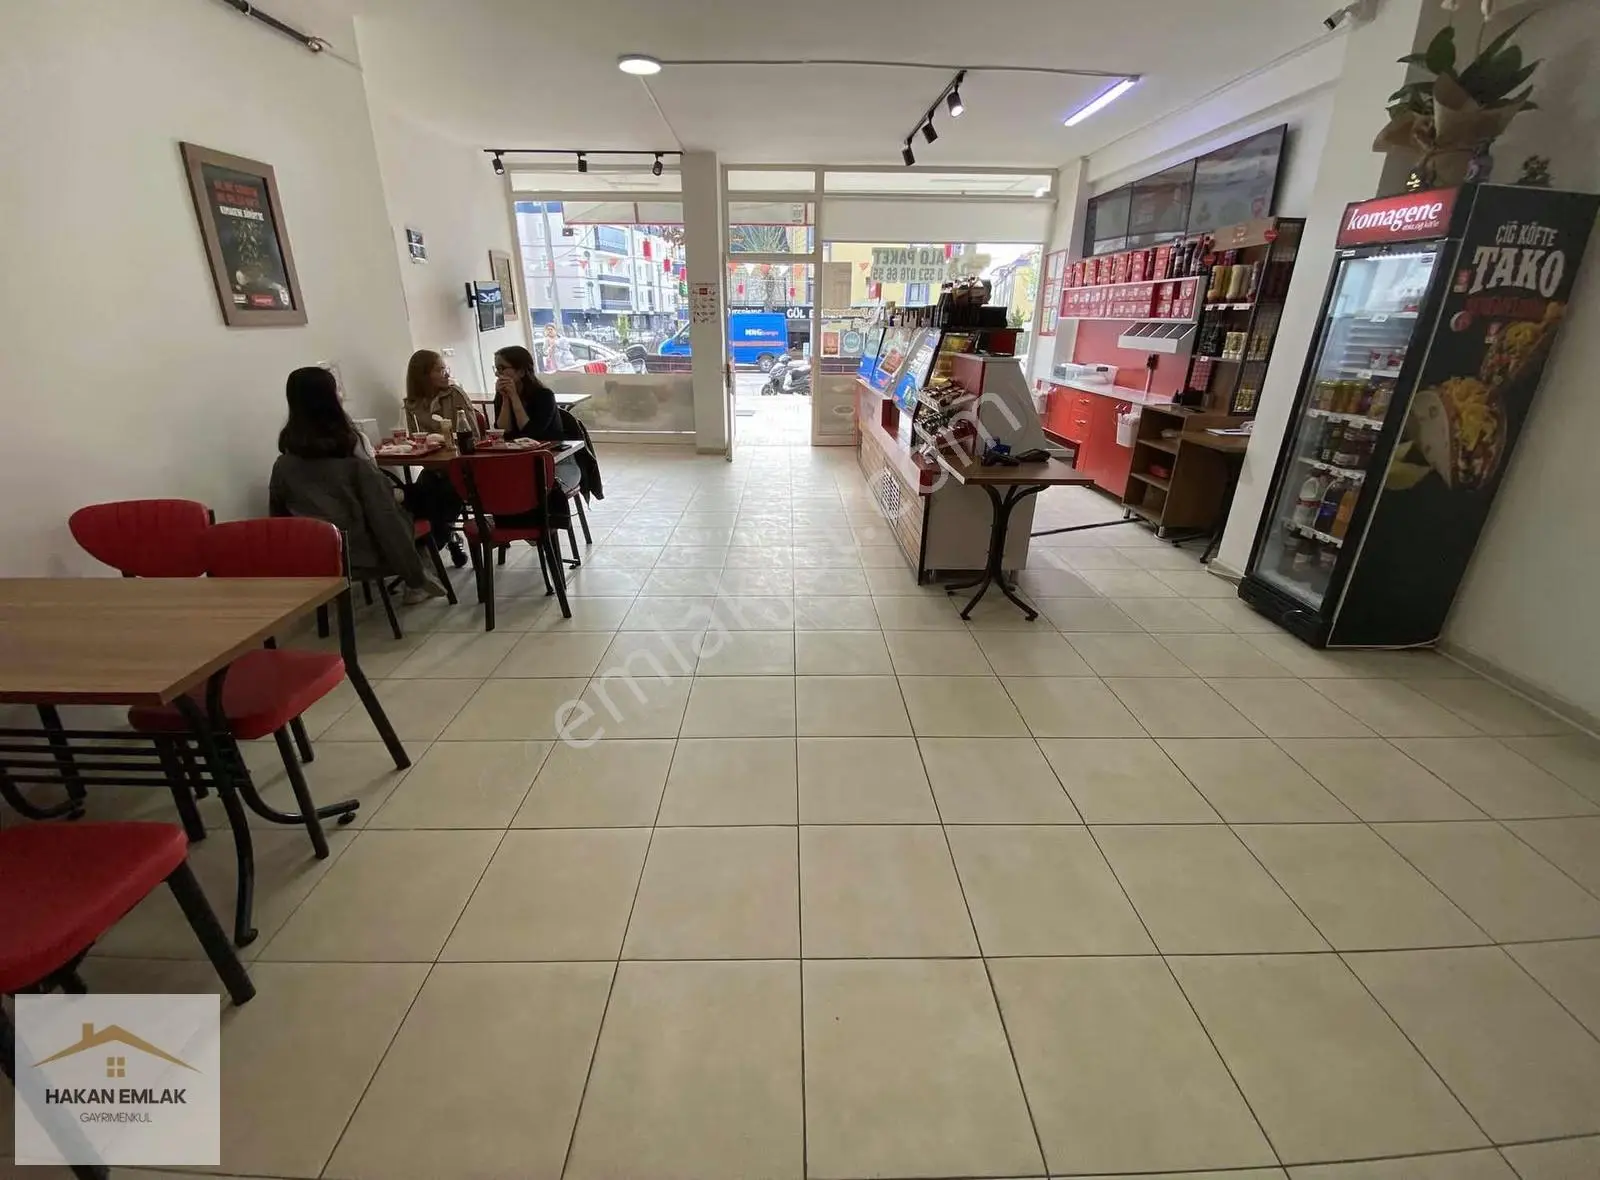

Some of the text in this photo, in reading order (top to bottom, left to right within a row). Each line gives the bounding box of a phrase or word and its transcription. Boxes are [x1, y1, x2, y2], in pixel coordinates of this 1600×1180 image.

[1346, 201, 1443, 232] komagene
[1517, 220, 1559, 247] KÖFTE
[1468, 245, 1565, 298] TAKO
[787, 306, 806, 319] GÜL
